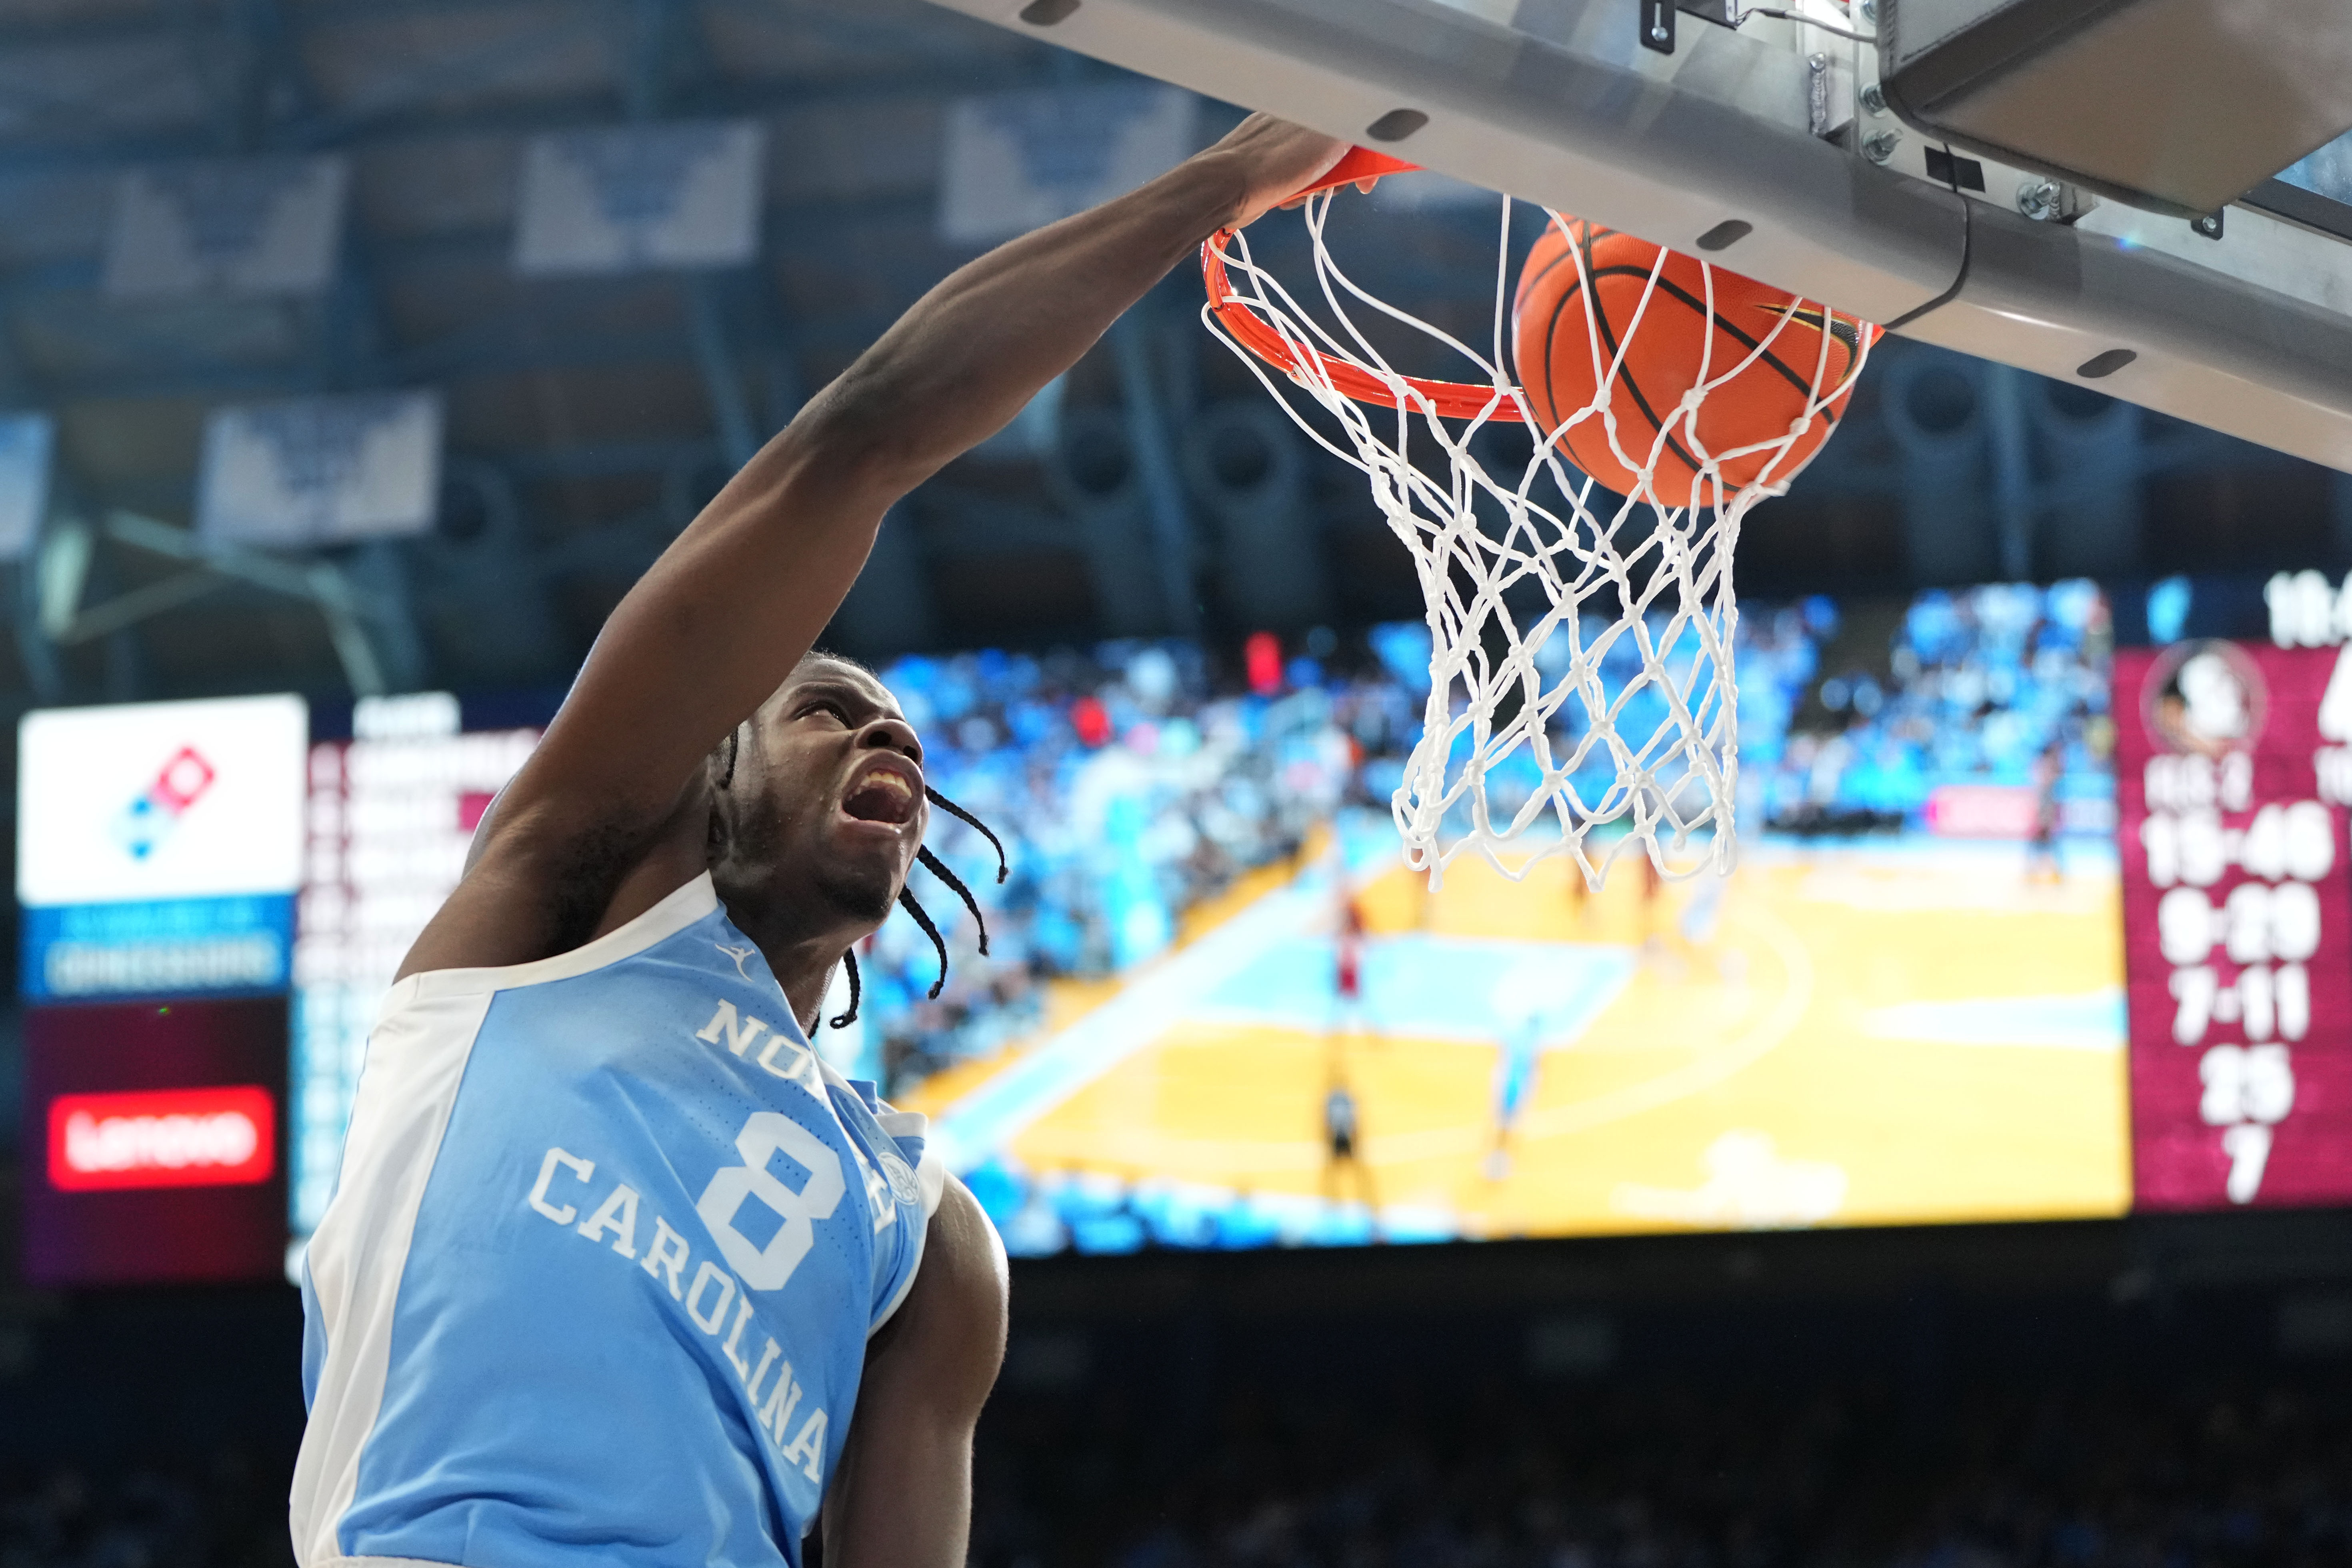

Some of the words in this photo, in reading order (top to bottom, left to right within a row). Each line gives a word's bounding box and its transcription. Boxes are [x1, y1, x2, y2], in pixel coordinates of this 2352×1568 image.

[66, 1110, 257, 1172] Lenovo
[696, 1111, 846, 1291] 8
[2222, 1122, 2272, 1203] 7
[529, 1147, 828, 1484] CAROLINA
